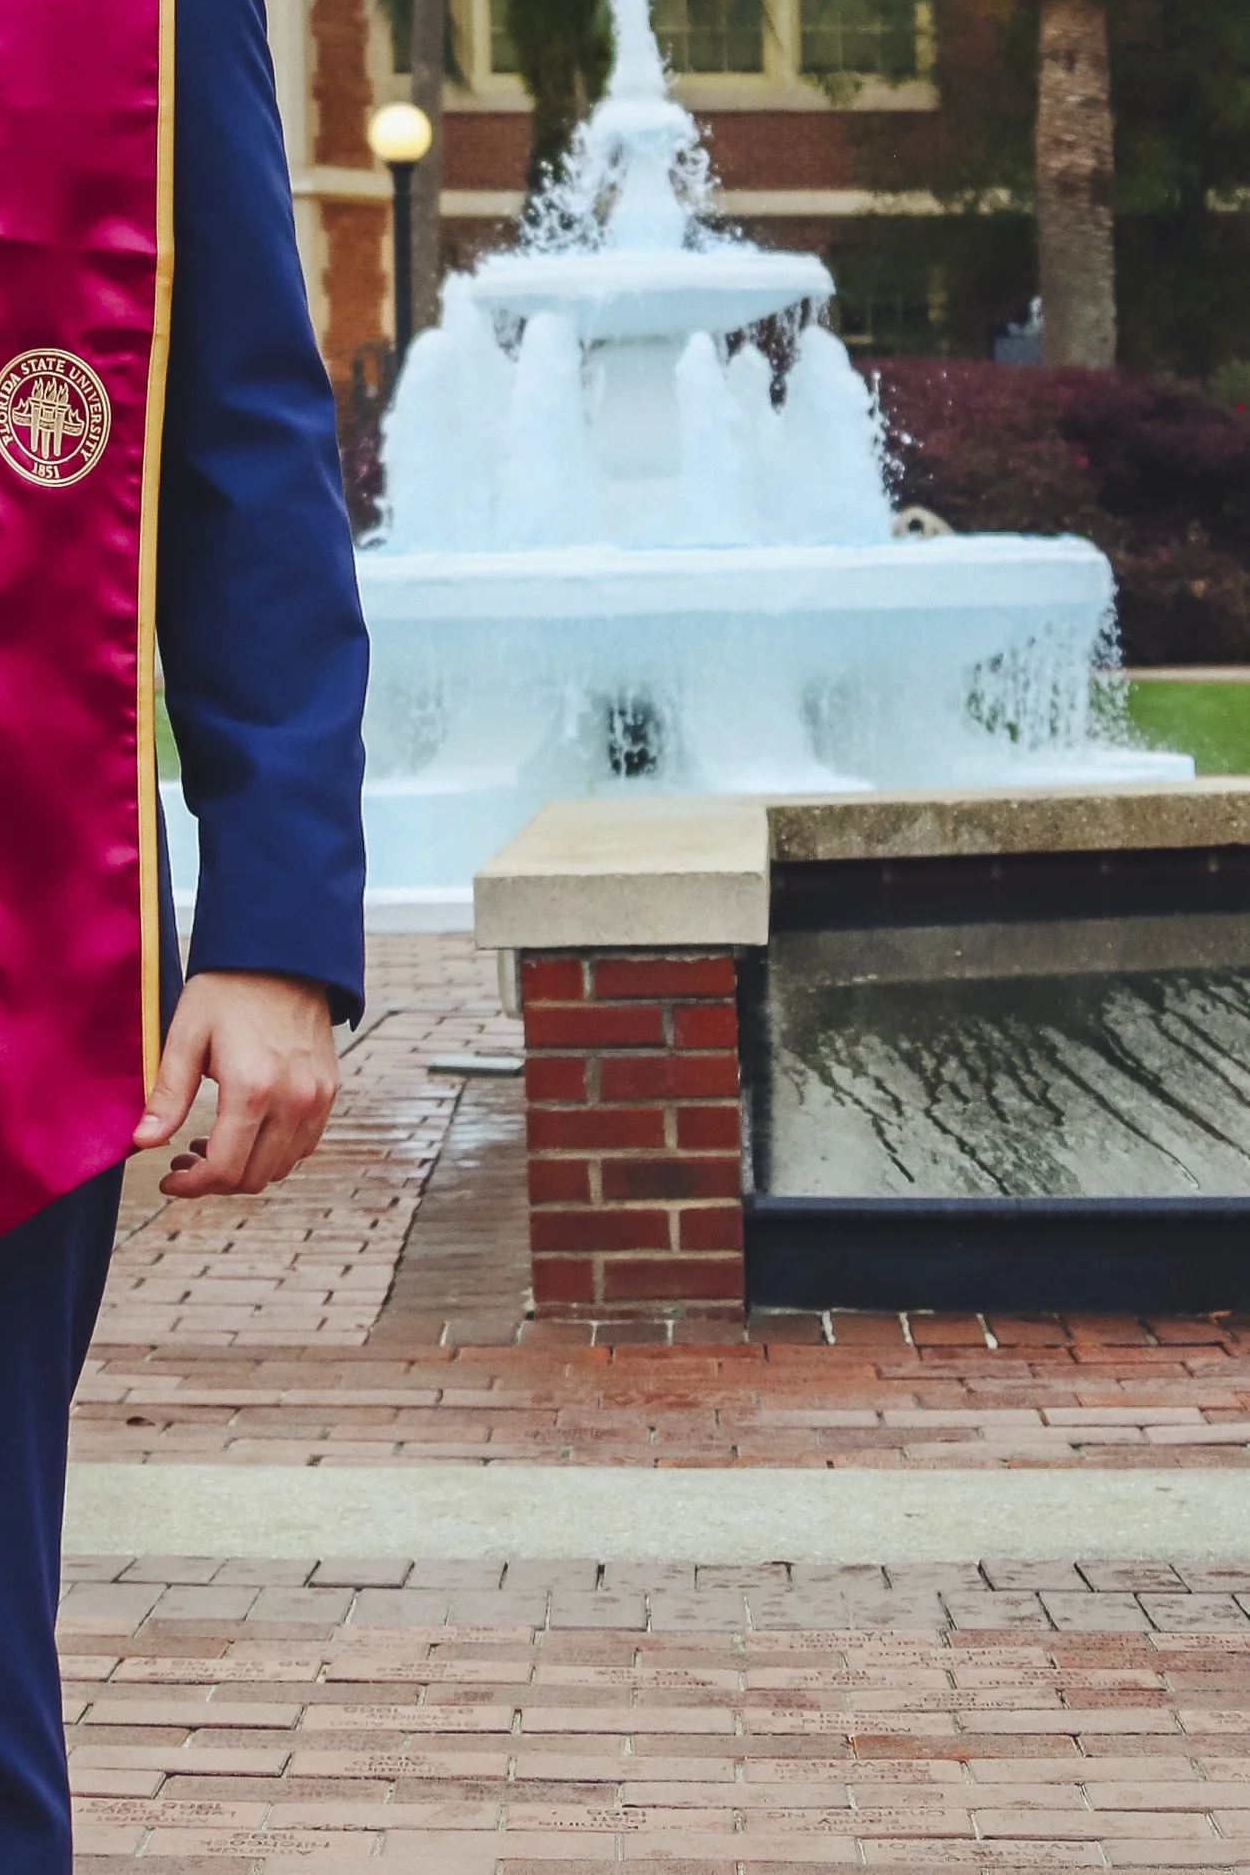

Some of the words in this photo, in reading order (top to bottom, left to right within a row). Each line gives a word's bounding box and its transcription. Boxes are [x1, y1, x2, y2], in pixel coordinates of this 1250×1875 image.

[20, 357, 66, 375] STATE
[68, 366, 102, 462] UNIVERSITY
[31, 463, 61, 478] 1851
